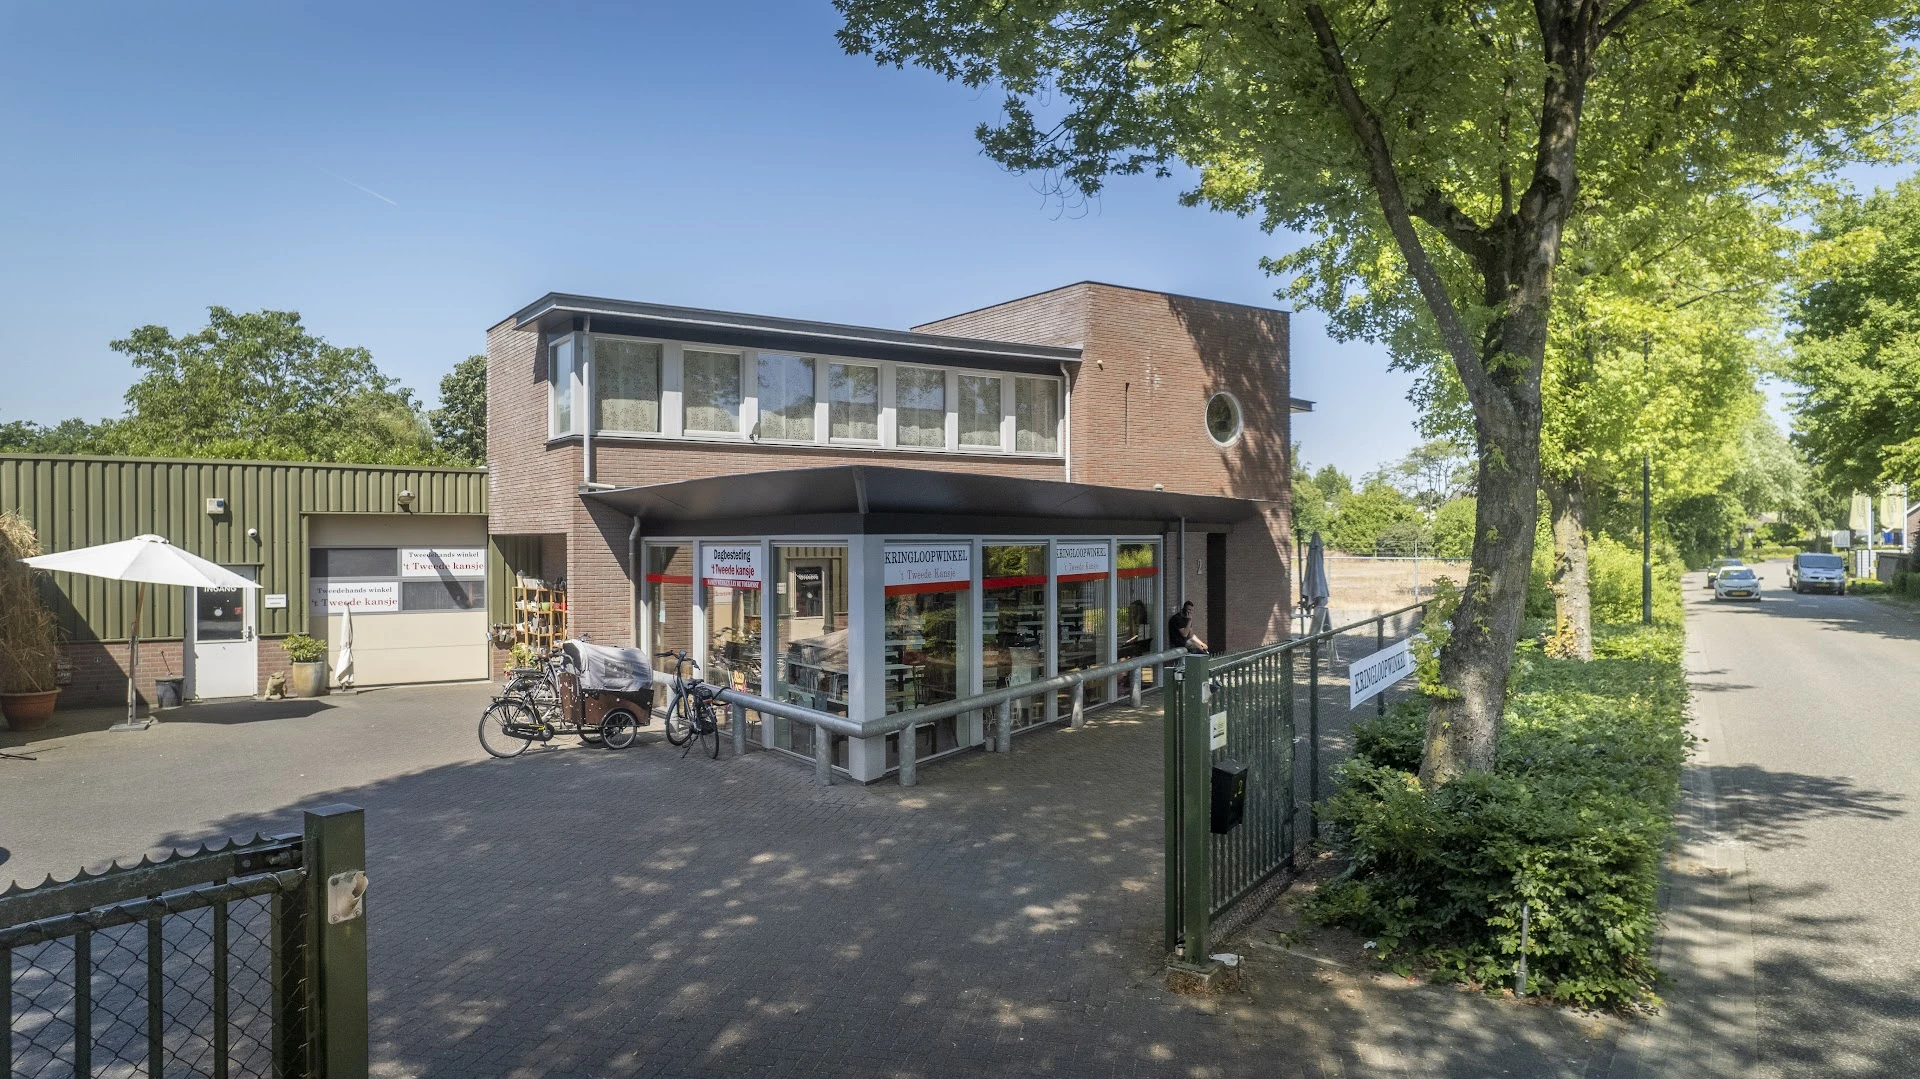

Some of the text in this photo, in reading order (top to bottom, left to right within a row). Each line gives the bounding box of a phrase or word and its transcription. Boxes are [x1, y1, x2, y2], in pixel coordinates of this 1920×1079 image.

[713, 549, 751, 562] Dagbesteding
[884, 550, 968, 564] KRINGLOOPWINKEL
[412, 562, 451, 570] Tweede
[453, 562, 484, 571] kansje
[715, 564, 735, 575] Tweede
[735, 565, 755, 578] kansje
[907, 569, 932, 580] Tweede
[934, 568, 956, 580] Kansje
[321, 598, 362, 607] Tweede
[364, 597, 398, 608] kansje
[1354, 650, 1406, 695] KRINGLOOPWINKEL
